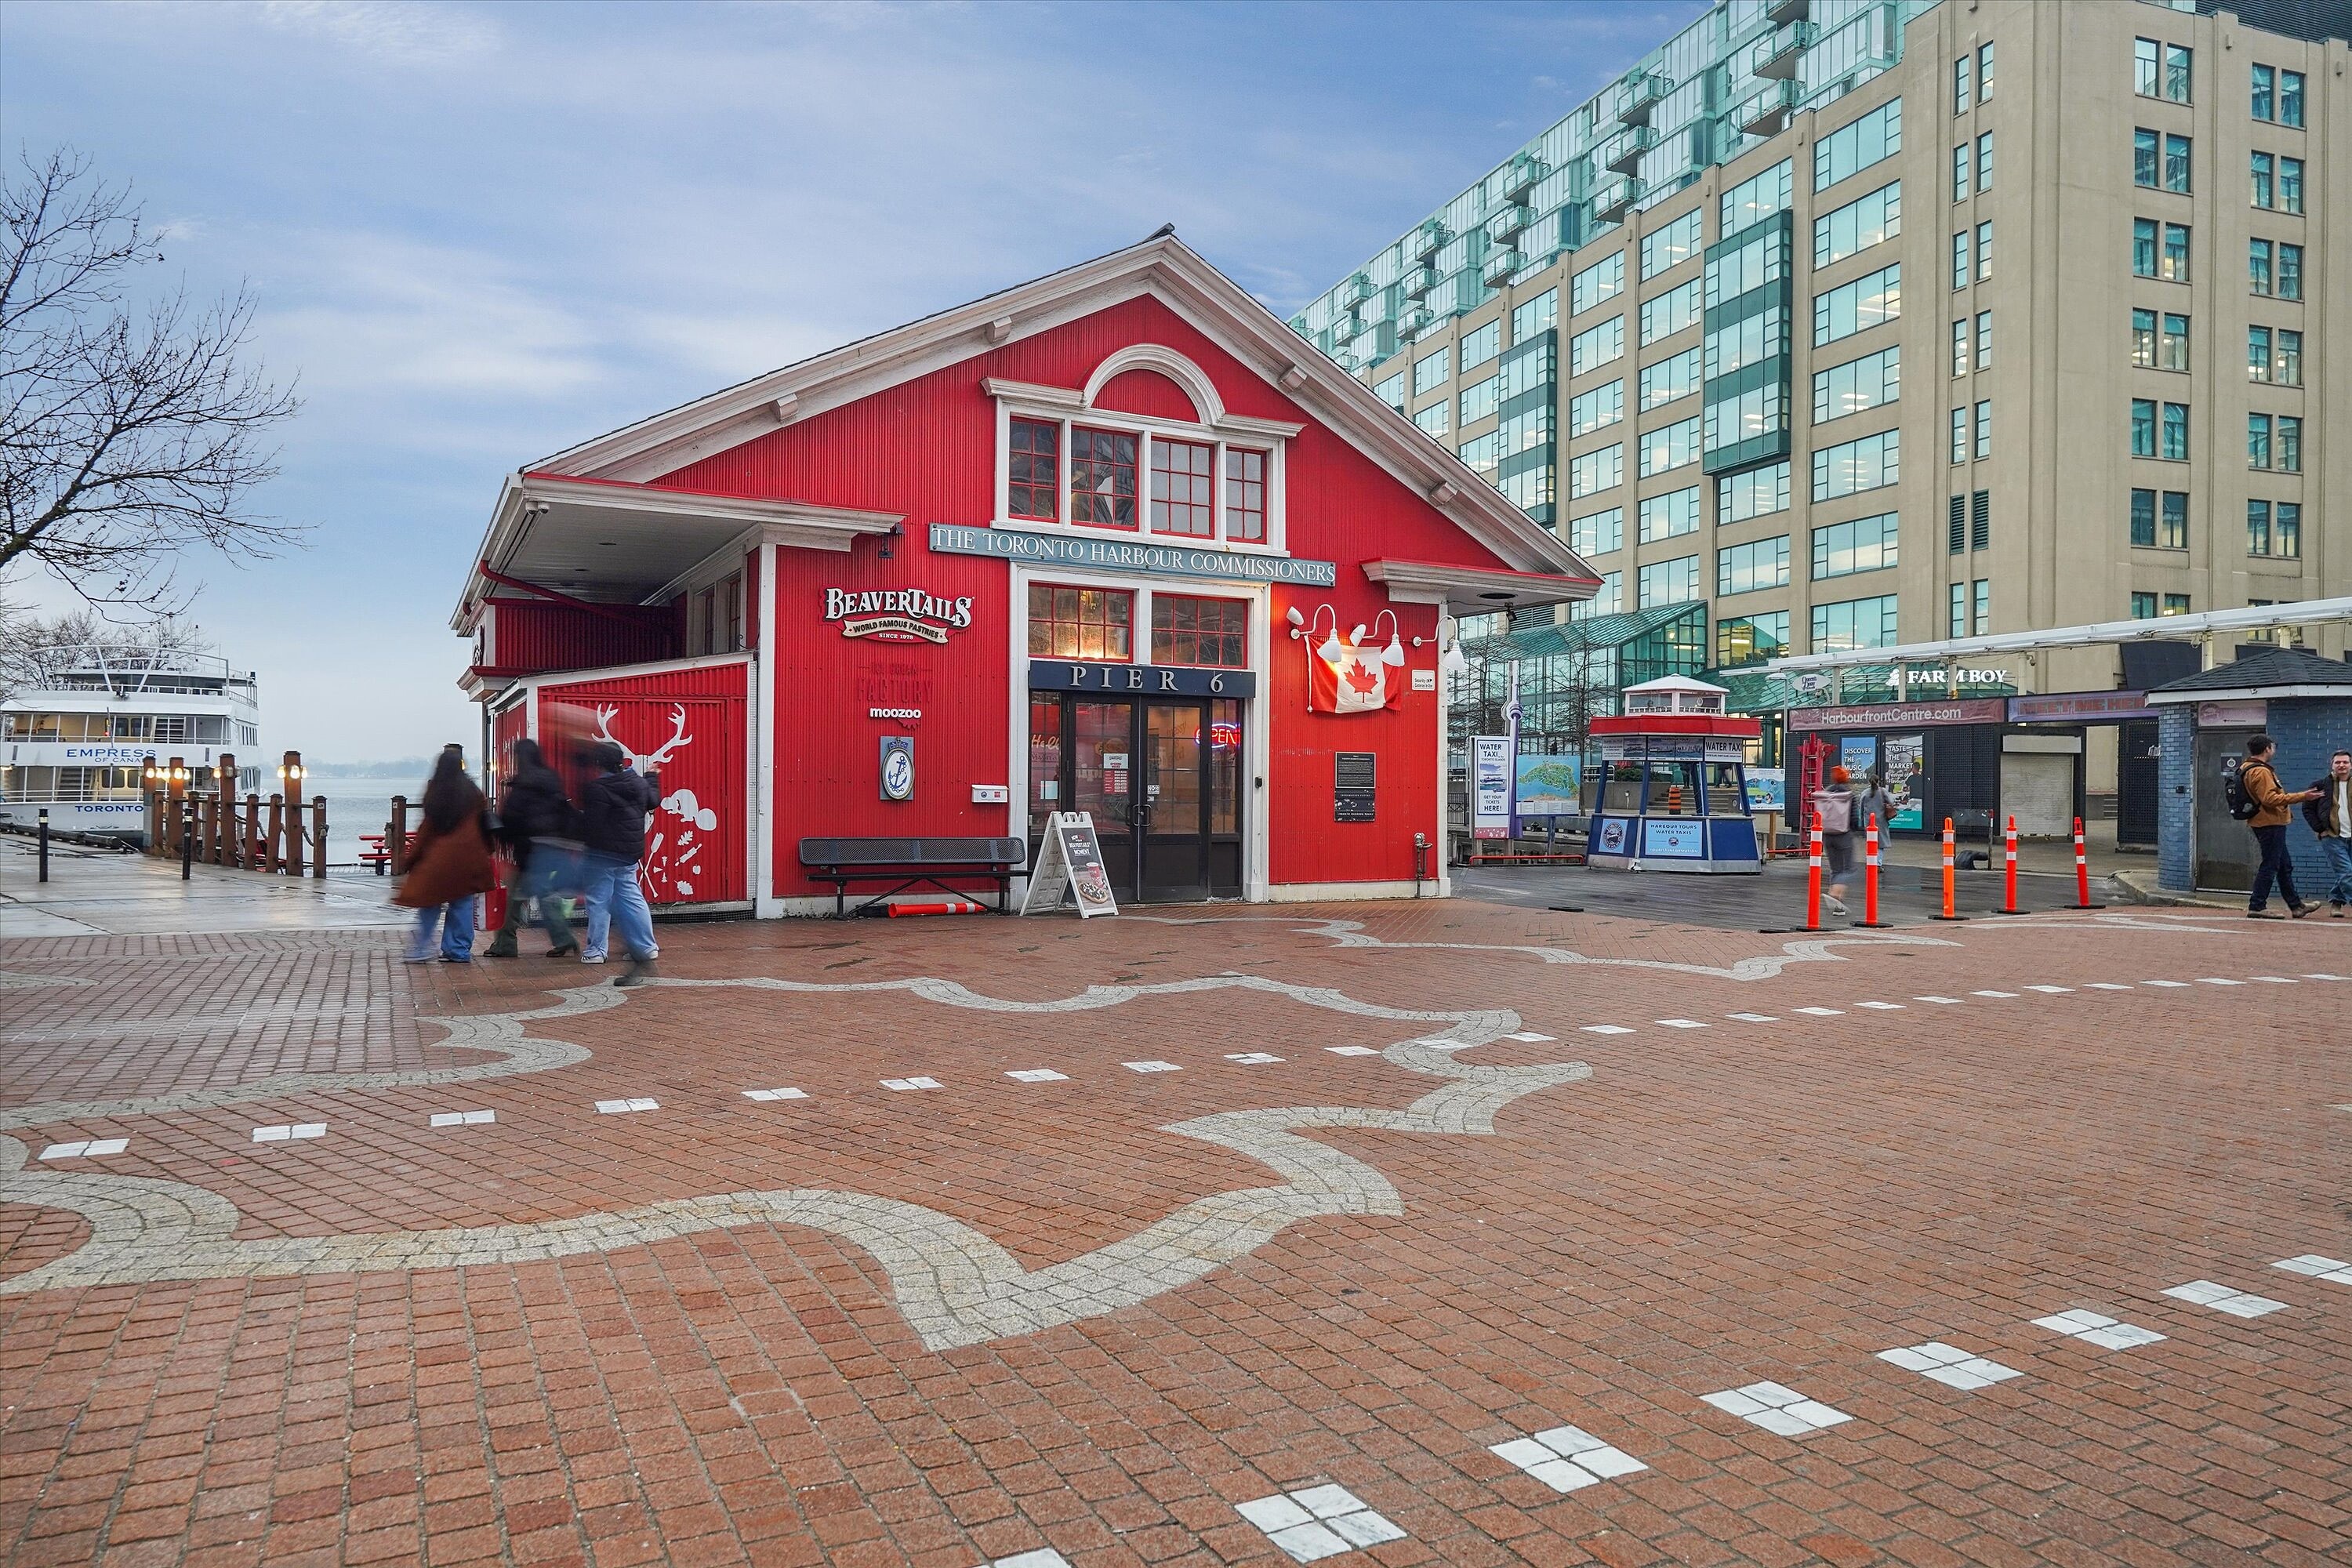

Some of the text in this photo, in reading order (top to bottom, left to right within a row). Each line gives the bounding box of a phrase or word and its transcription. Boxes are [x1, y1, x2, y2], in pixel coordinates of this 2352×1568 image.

[931, 528, 1335, 583] THE TORONTO HARBOUR COMMISSIONERS
[853, 620, 939, 638] WORLD FAMOUS PASTRIES
[1069, 666, 1225, 693] PIER 6
[1969, 670, 2007, 683] BOY
[857, 677, 933, 703] FACTORY
[869, 707, 922, 718] moozoo
[2074, 699, 2106, 711] ME
[2107, 697, 2146, 710] HER
[1821, 707, 1962, 724] HarbourfrontCentre.com
[1706, 742, 1742, 752] WATER TAXI
